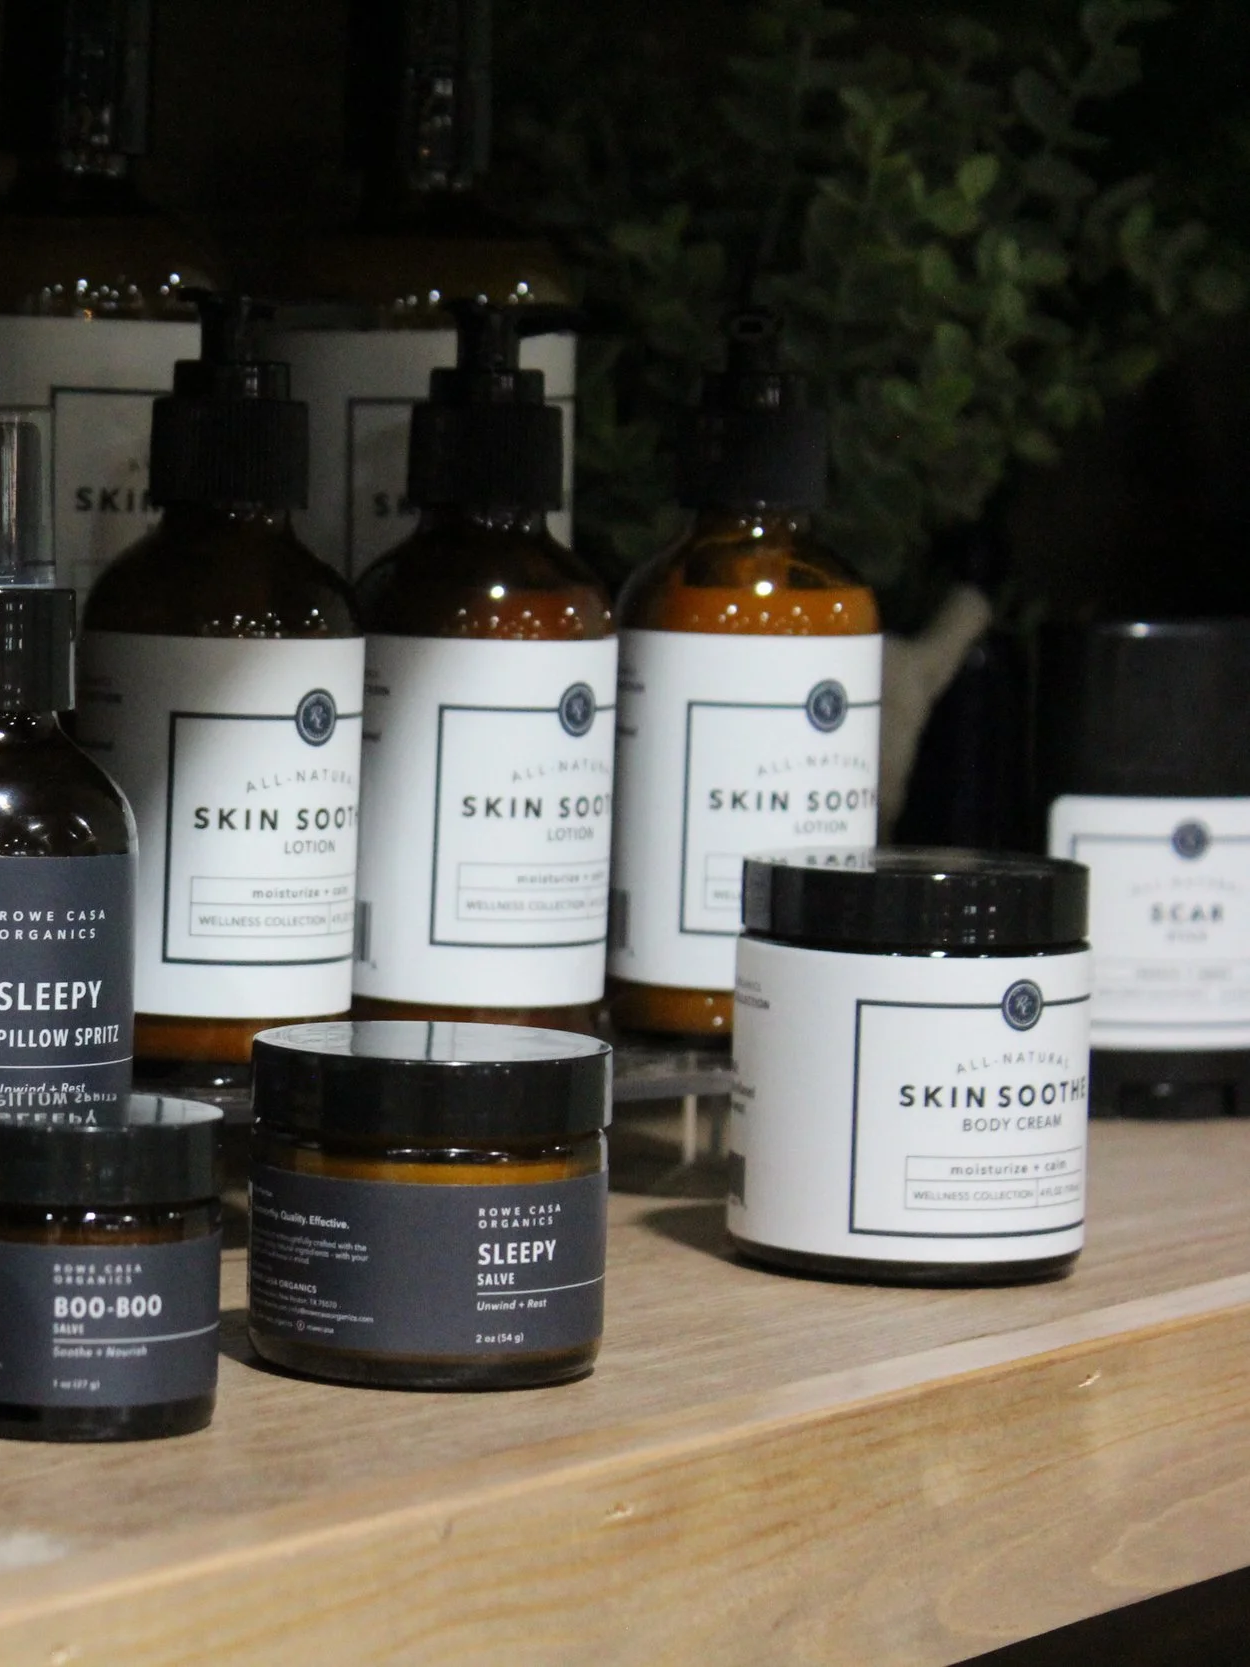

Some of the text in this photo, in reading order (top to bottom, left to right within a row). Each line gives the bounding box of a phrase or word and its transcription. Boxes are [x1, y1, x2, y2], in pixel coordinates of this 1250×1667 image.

[709, 787, 879, 812] SKIN SOOTH
[462, 796, 543, 818] SKIN
[194, 807, 278, 830] SKIN
[547, 826, 595, 842] LOTION
[794, 820, 848, 834] LOTION
[284, 840, 336, 854] LOTION
[252, 887, 320, 899] moisturize
[0, 909, 106, 921] ROWE CASA
[198, 914, 327, 927] WELLNESS COLLECTION
[75, 1024, 120, 1046] SPRITZ
[957, 1051, 1070, 1074] ALL-NATURAL
[61, 1082, 86, 1093] Rest
[899, 1084, 986, 1108] SKIN
[962, 1114, 1062, 1132] BODY CREAM
[950, 1163, 1028, 1176] moisturize
[913, 1190, 970, 1201] WELLNESS
[973, 1188, 1034, 1201] COLLECTION
[478, 1203, 561, 1217] ROWE CASA
[309, 1215, 350, 1230] Effective.
[478, 1216, 554, 1229] ORGANICS
[477, 1239, 557, 1266] SLEEPY
[53, 1263, 143, 1275] ROWE CASA
[53, 1275, 133, 1286] ORGANICS
[477, 1272, 515, 1286] SALVE
[278, 1279, 317, 1294] ORGANICS
[54, 1294, 162, 1319] BOO-BOO
[477, 1299, 517, 1311] Unwind
[527, 1298, 547, 1308] Rest
[53, 1323, 85, 1335] SALVE
[475, 1334, 482, 1344] 2
[484, 1335, 496, 1343] oz
